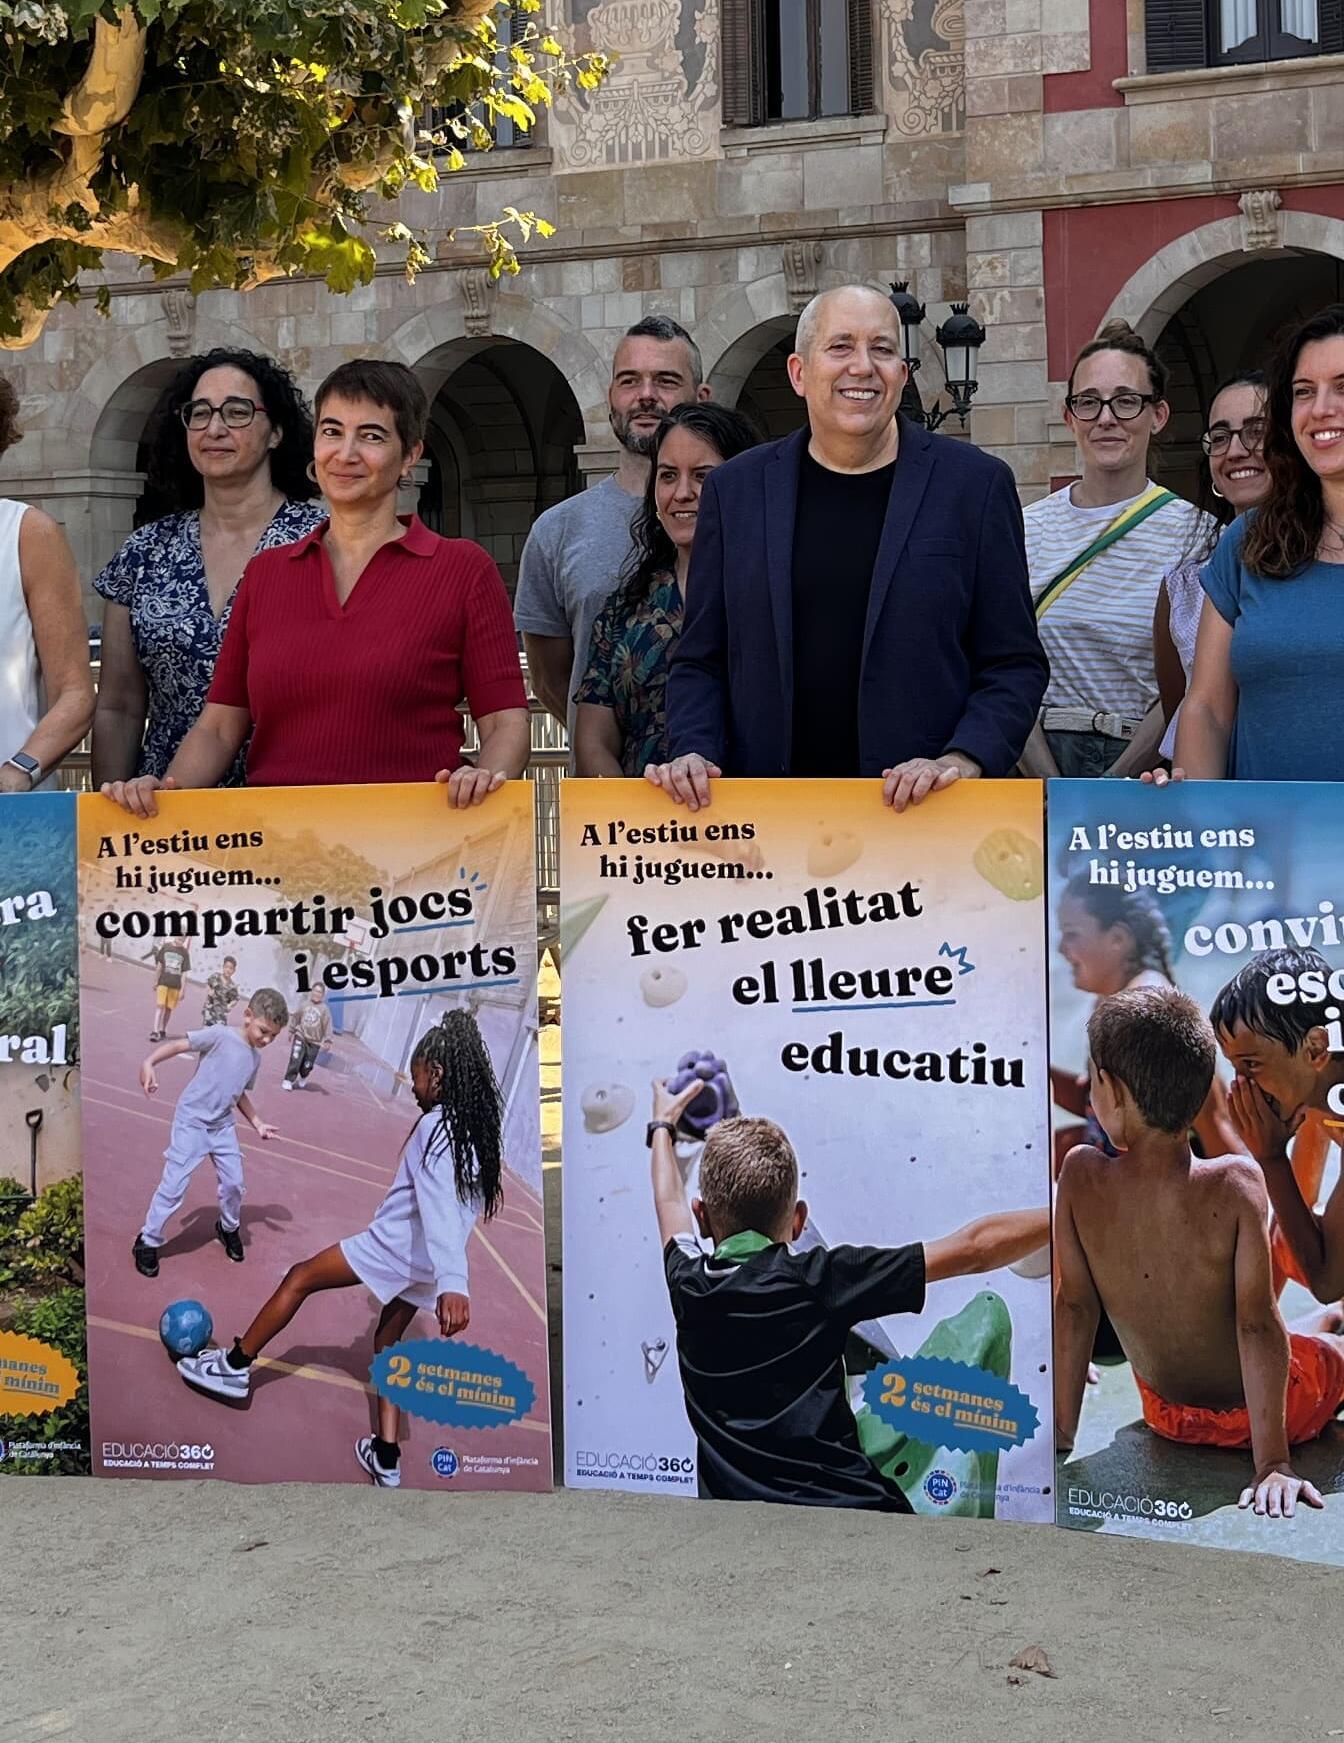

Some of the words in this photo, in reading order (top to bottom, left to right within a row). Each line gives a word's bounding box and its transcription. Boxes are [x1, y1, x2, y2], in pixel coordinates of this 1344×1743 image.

[97, 837, 117, 859] A
[123, 831, 209, 856] l'estiu
[215, 831, 263, 851] ens
[580, 824, 601, 846] A
[608, 819, 698, 845] l'estiu
[704, 821, 755, 840] ens
[1069, 827, 1091, 851] A
[1097, 823, 1194, 850] l'estiu
[1200, 827, 1255, 848] ens
[116, 866, 142, 888] hi
[147, 867, 281, 893] juguem...
[599, 855, 627, 878] hi
[632, 856, 773, 885] juguem...
[1089, 860, 1120, 885] hi
[1123, 861, 1274, 893] juguem...
[95, 895, 355, 947] compartir
[369, 887, 472, 939] jocs
[627, 915, 706, 957] fer
[717, 881, 922, 944] realitat
[294, 954, 311, 992] i
[323, 942, 516, 997] esports
[732, 960, 779, 1005] el
[792, 958, 953, 1002] lleure
[781, 1031, 1025, 1088] educatiu
[387, 1355, 411, 1387] 2
[417, 1363, 502, 1388] setmanes
[416, 1377, 434, 1393] és
[438, 1380, 454, 1396] el
[880, 1373, 905, 1407] 2
[913, 1382, 1004, 1411] setmanes
[911, 1397, 930, 1413] és
[935, 1402, 952, 1418] el
